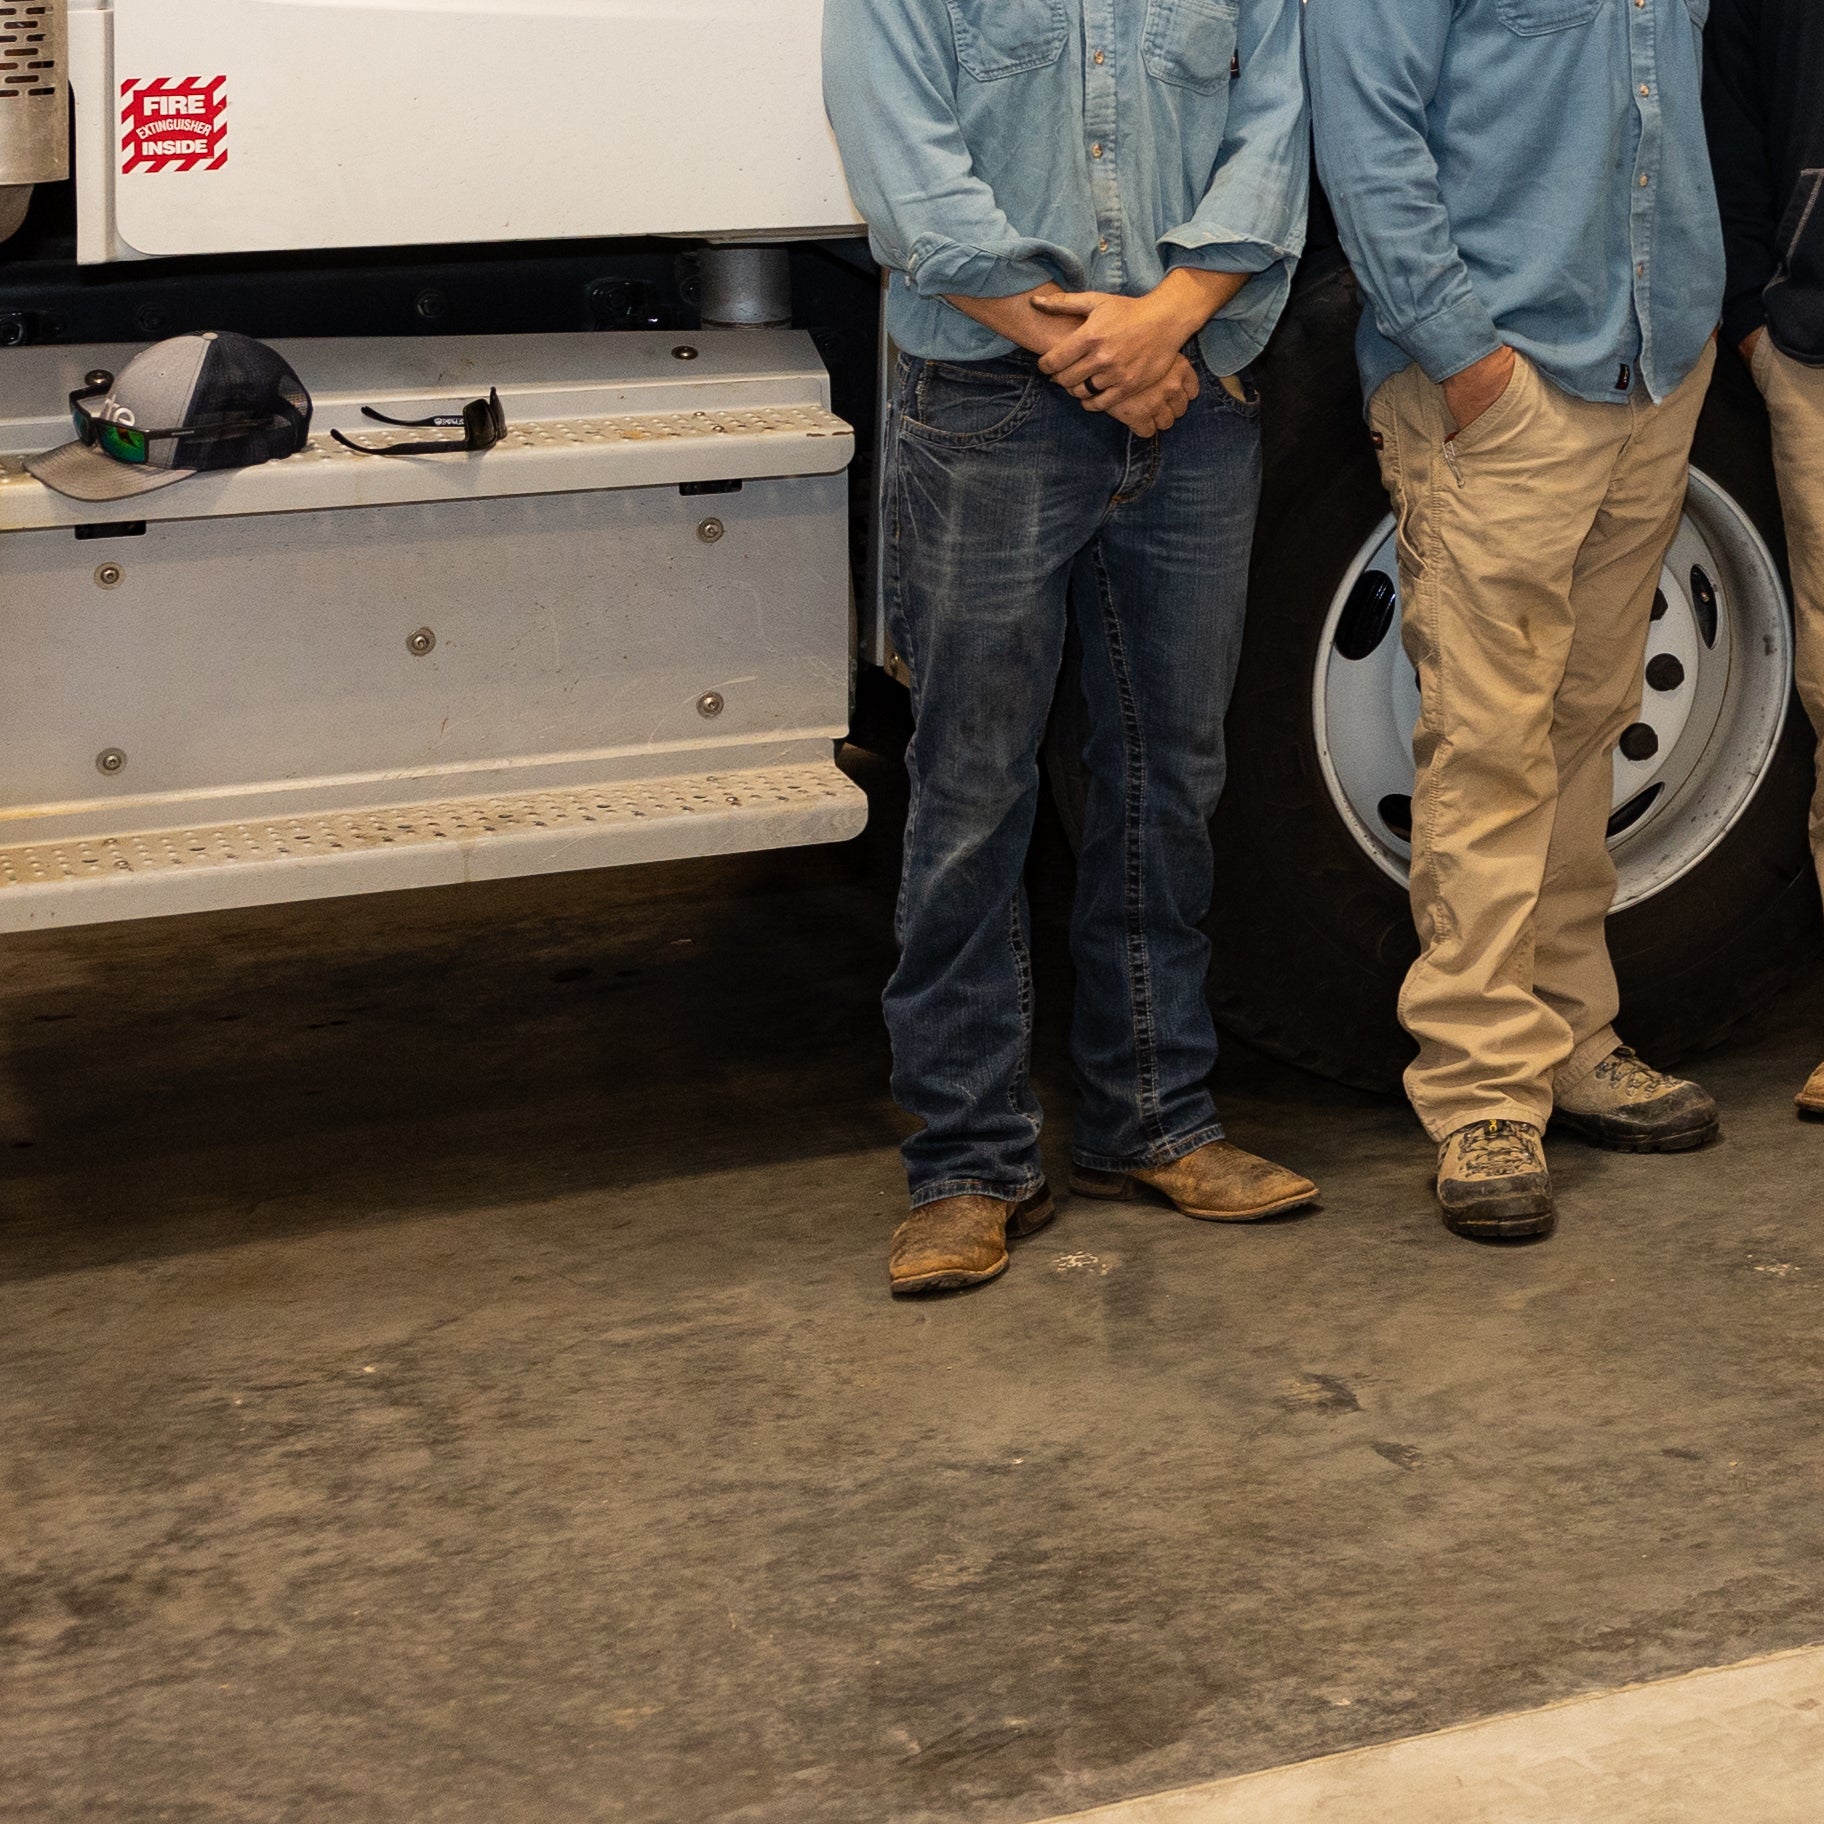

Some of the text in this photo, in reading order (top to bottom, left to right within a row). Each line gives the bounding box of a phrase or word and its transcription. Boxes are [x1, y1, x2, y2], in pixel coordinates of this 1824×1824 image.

[143, 94, 206, 116] FIRE
[135, 118, 212, 140] EXTINGUISHER
[141, 139, 208, 156] INSIDE
